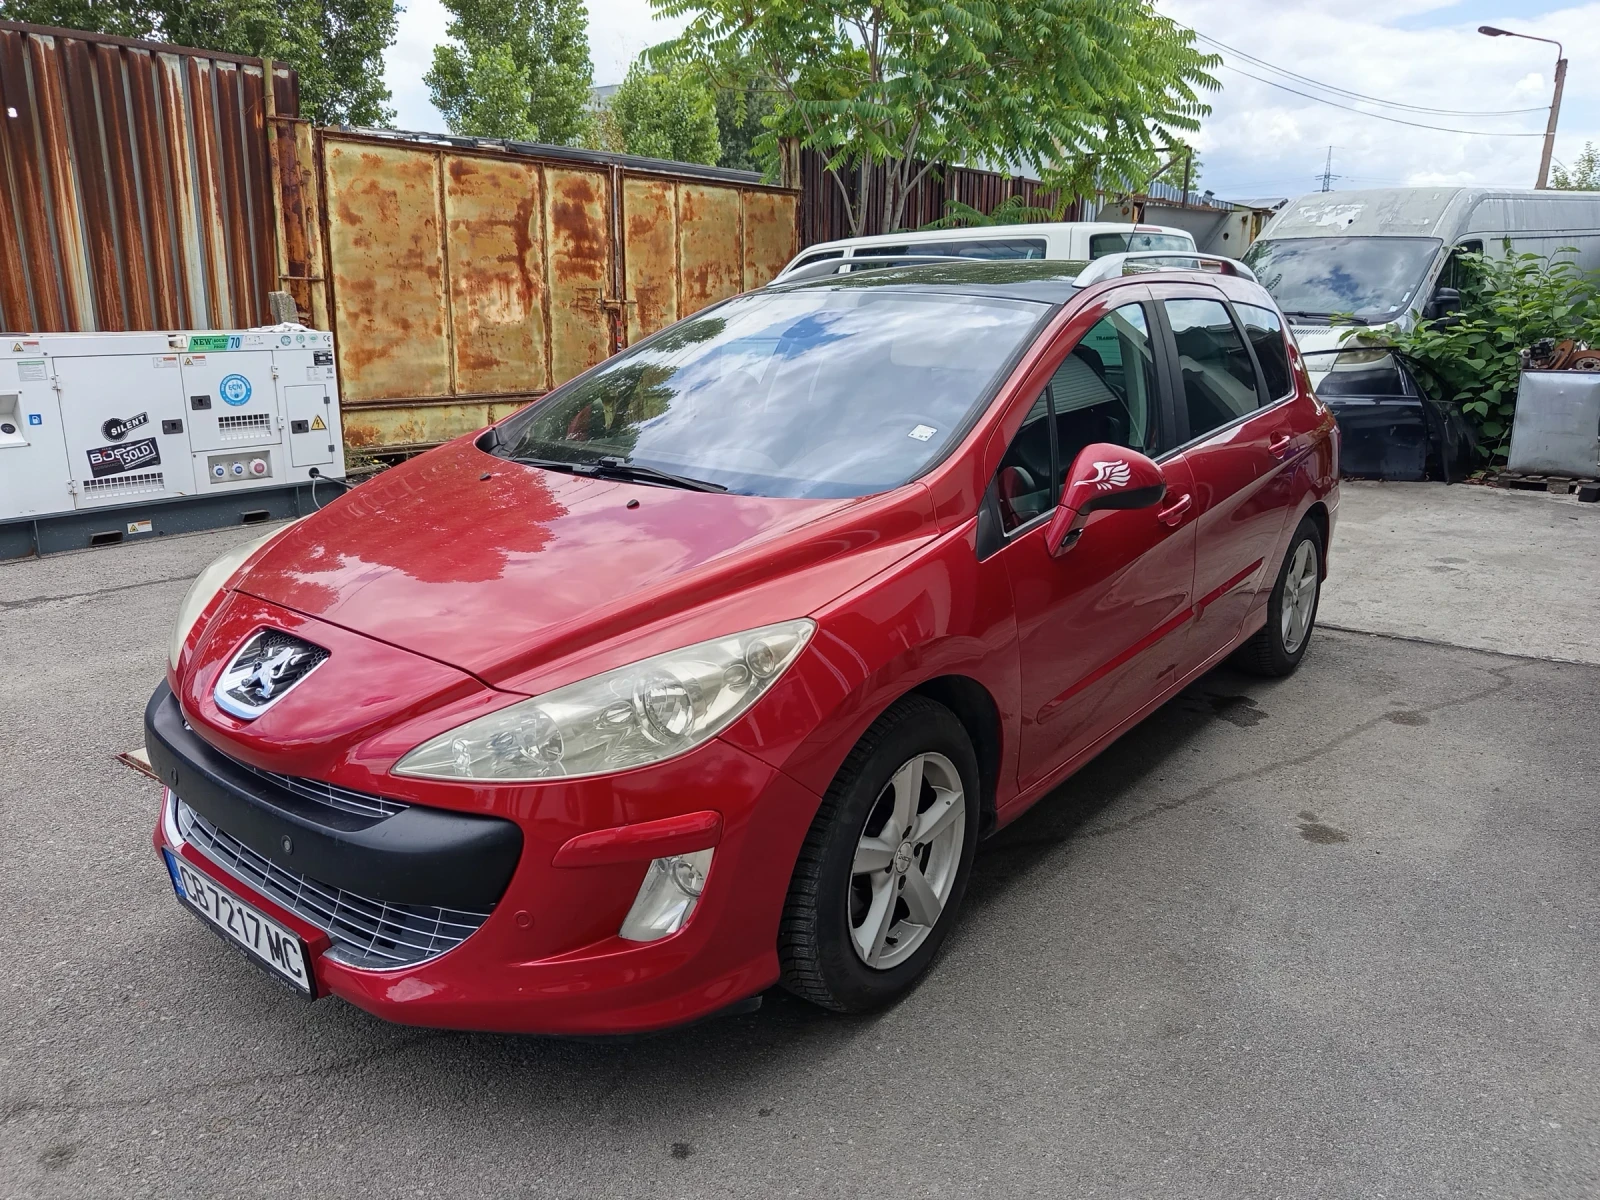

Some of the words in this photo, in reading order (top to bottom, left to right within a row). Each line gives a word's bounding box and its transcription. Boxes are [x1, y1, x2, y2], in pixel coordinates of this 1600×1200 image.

[192, 338, 213, 346] NEW
[230, 337, 241, 349] 70
[111, 416, 144, 436] SILENT
[122, 445, 150, 463] SOLD
[180, 866, 209, 911] CB
[207, 885, 260, 949] 7217
[264, 923, 302, 978] MC
